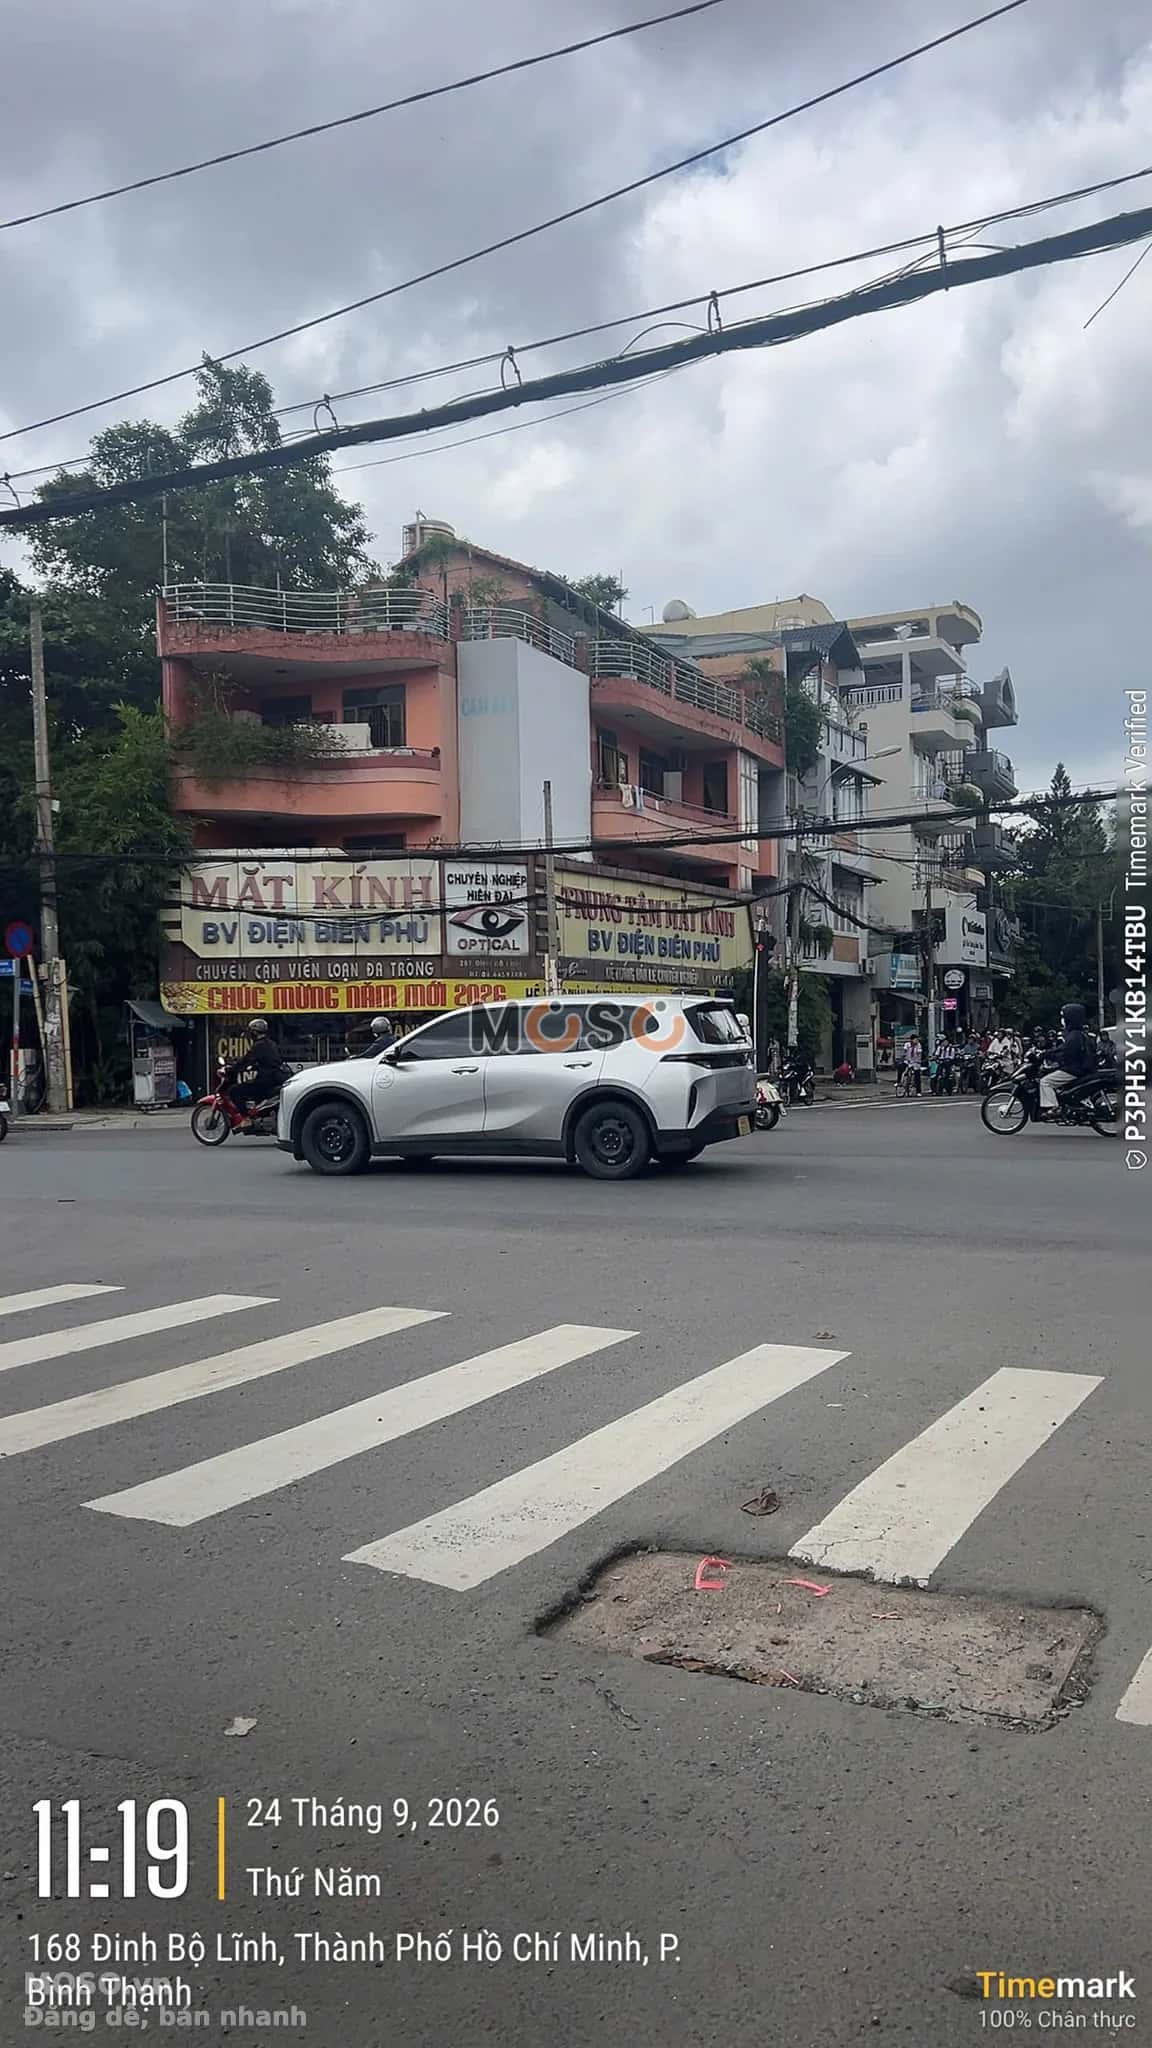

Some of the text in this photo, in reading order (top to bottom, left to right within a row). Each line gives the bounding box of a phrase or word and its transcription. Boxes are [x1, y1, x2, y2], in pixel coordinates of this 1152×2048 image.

[311, 865, 433, 909] KÍNH
[203, 922, 238, 944] BV
[247, 919, 305, 949] ĐIỆN
[380, 915, 429, 944] PHỦ
[457, 938, 521, 951] OPTICAL
[588, 928, 721, 962] BV ĐIỆN BIÊN PHỦ
[254, 960, 280, 983] CẬN
[327, 961, 359, 982] LOẠN
[366, 962, 383, 977] ĐA
[207, 984, 266, 1009] CHÚC
[272, 982, 339, 1009] MỪNG
[346, 981, 397, 1008] NĂM
[404, 980, 448, 1007] MỚI
[453, 983, 507, 1006] 2026
